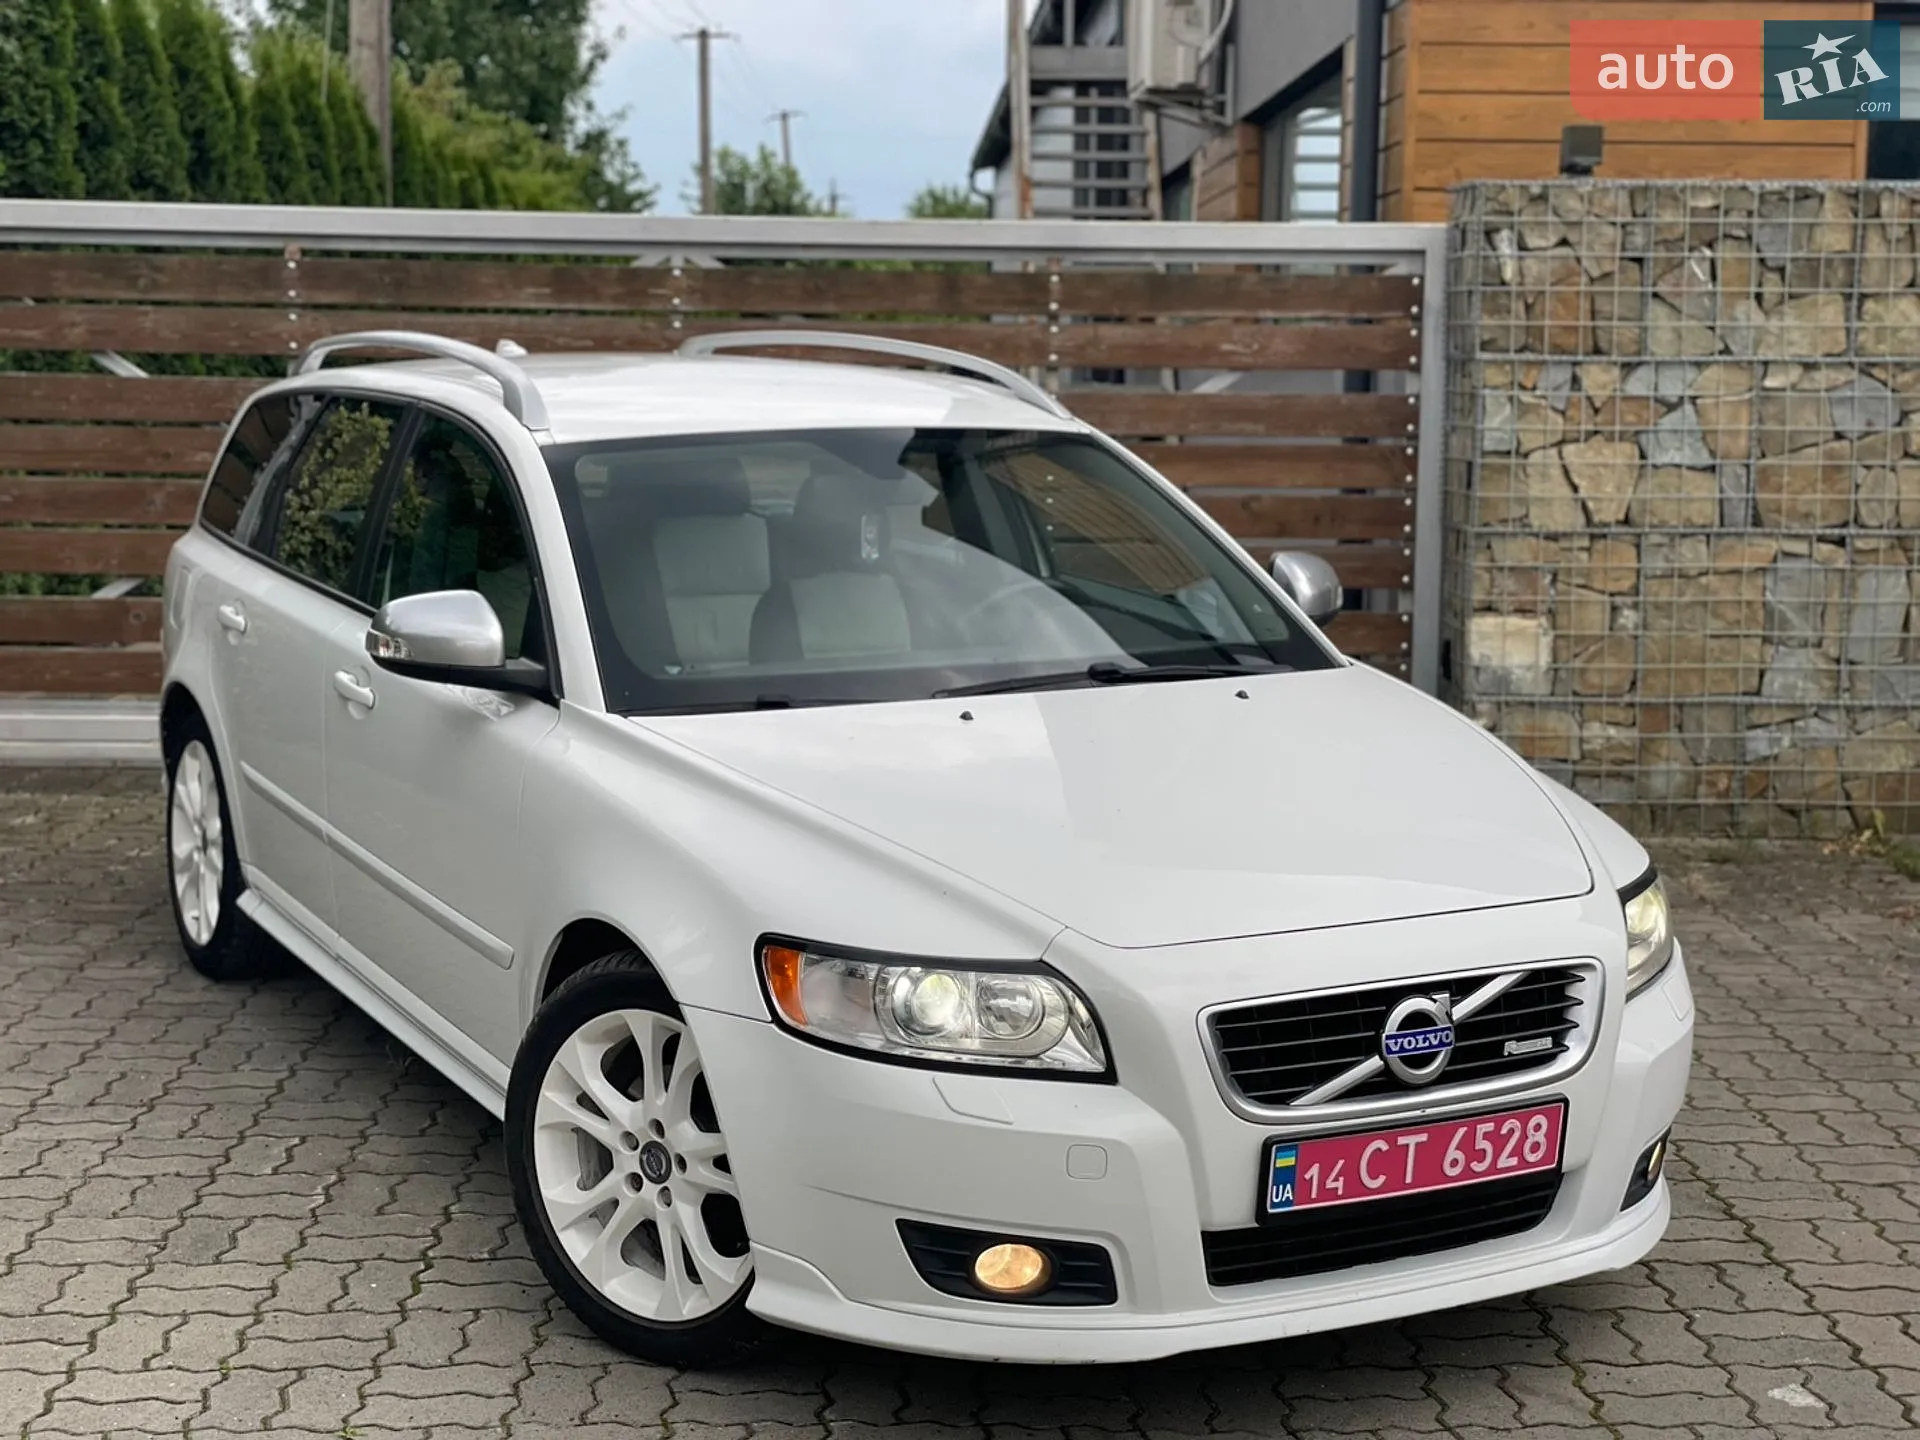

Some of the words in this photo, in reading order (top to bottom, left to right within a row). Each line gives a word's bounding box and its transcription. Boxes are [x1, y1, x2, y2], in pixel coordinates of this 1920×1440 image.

[1385, 1030, 1452, 1052] VOLVO
[1304, 1158, 1345, 1199] 14
[1359, 1133, 1428, 1189] CT
[1442, 1114, 1548, 1177] 6528
[1272, 1184, 1293, 1202] UA
